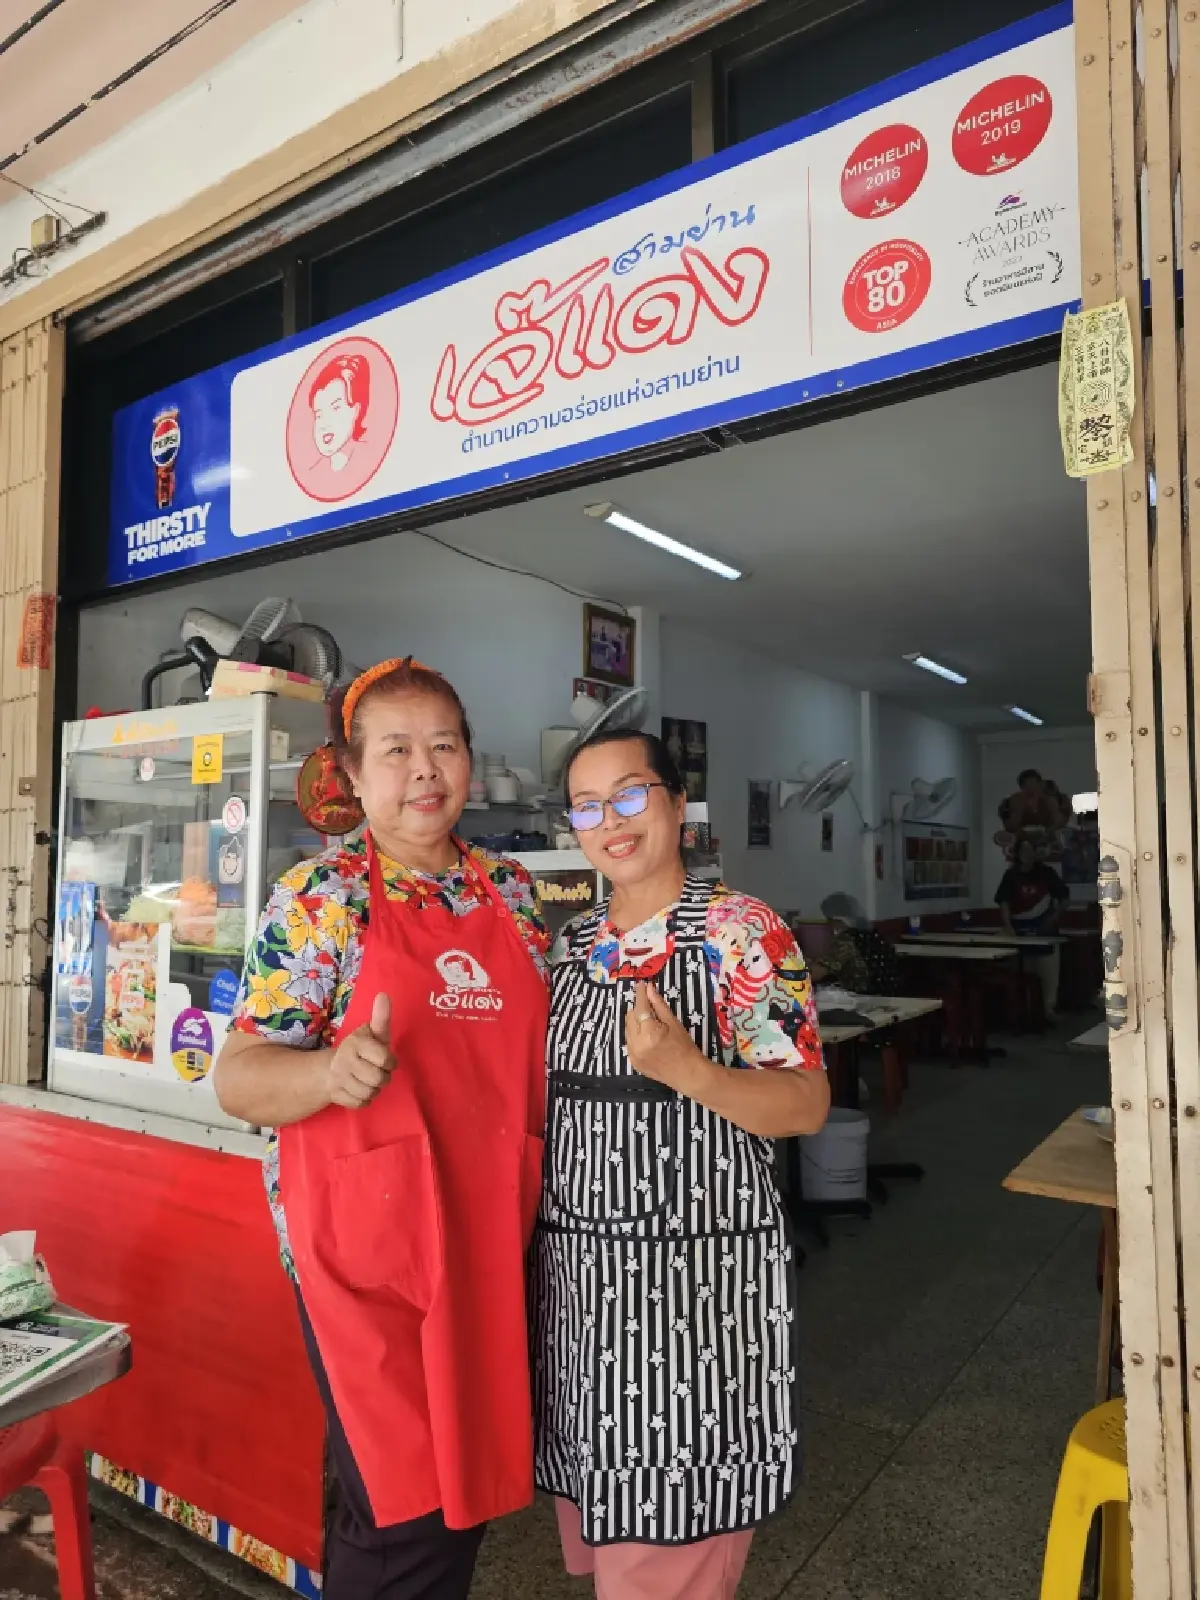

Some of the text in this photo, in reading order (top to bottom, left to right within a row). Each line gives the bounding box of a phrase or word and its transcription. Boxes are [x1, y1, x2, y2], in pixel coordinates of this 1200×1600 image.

[957, 90, 1046, 135] MICHELIN
[980, 119, 1022, 146] 2019
[843, 138, 922, 181] MICHELIN
[865, 166, 902, 191] 2018
[612, 203, 756, 275] สามย่าน
[966, 204, 1057, 248] ACADEMY
[972, 227, 1051, 265] AWARDS
[863, 260, 909, 290] TOP
[868, 280, 906, 313] 80
[461, 355, 740, 453] ตำนานความอร่อยแห่งสามย่าน
[153, 434, 179, 451] PEPSI
[124, 501, 212, 549] THIRSTY
[127, 530, 206, 565] FOR MORE
